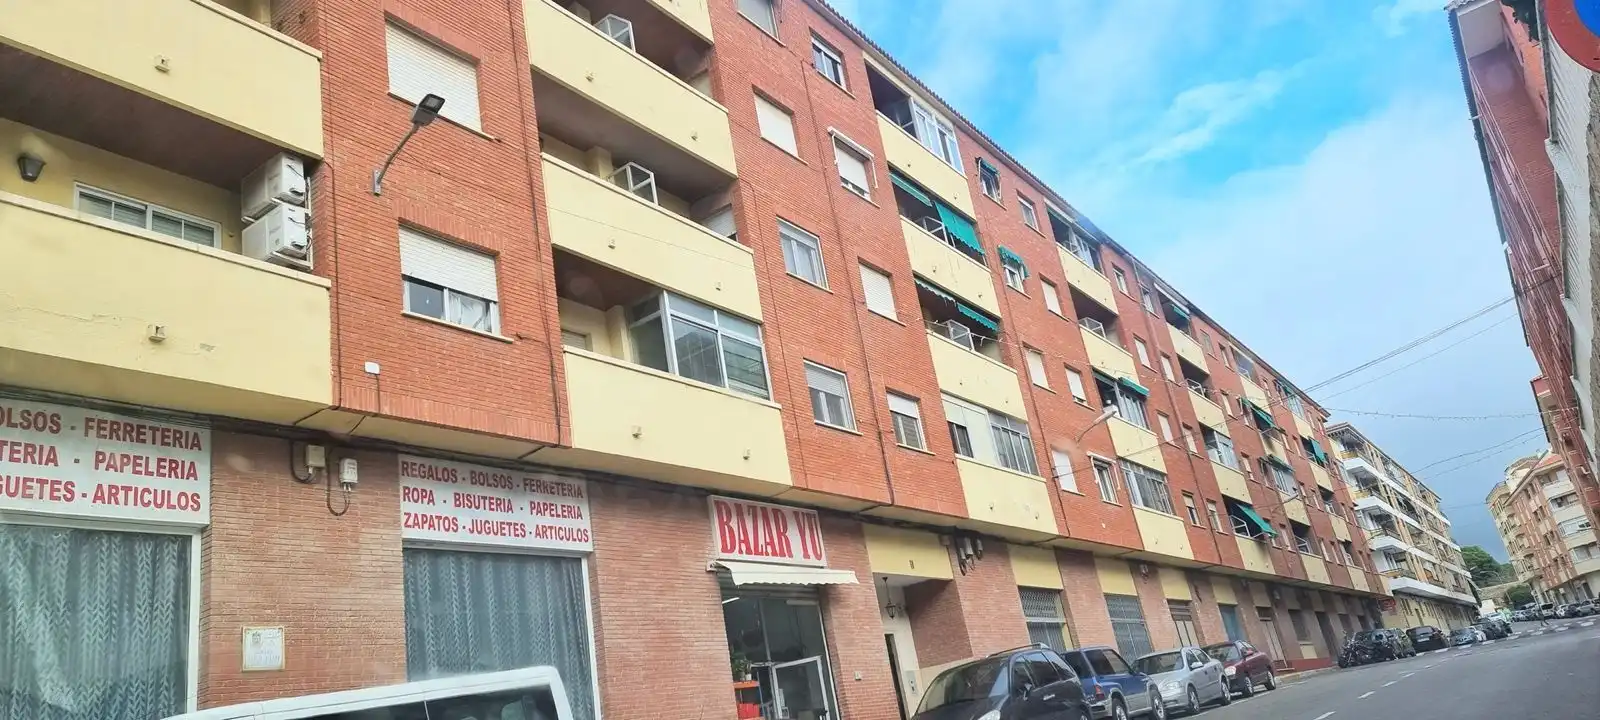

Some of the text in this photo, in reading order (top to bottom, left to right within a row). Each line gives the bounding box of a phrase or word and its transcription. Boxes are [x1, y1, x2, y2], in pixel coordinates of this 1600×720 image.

[84, 417, 202, 451] FERRETERIA
[95, 451, 198, 481] PAPELERIA
[401, 460, 457, 483] REGALOS
[470, 470, 513, 490] BOLSOS
[523, 478, 583, 498] FERRETERIA
[0, 475, 75, 502] UETES
[92, 484, 201, 512] ARTICULOS
[403, 486, 435, 506] ROPA
[454, 492, 513, 513] BISUTERIA
[530, 501, 583, 520] PAPELERIA
[404, 512, 458, 532] ZAPATOS
[469, 519, 526, 537] JUGUETES
[535, 525, 589, 543] ARTICULOS
[714, 500, 822, 561] BAZAR YU
